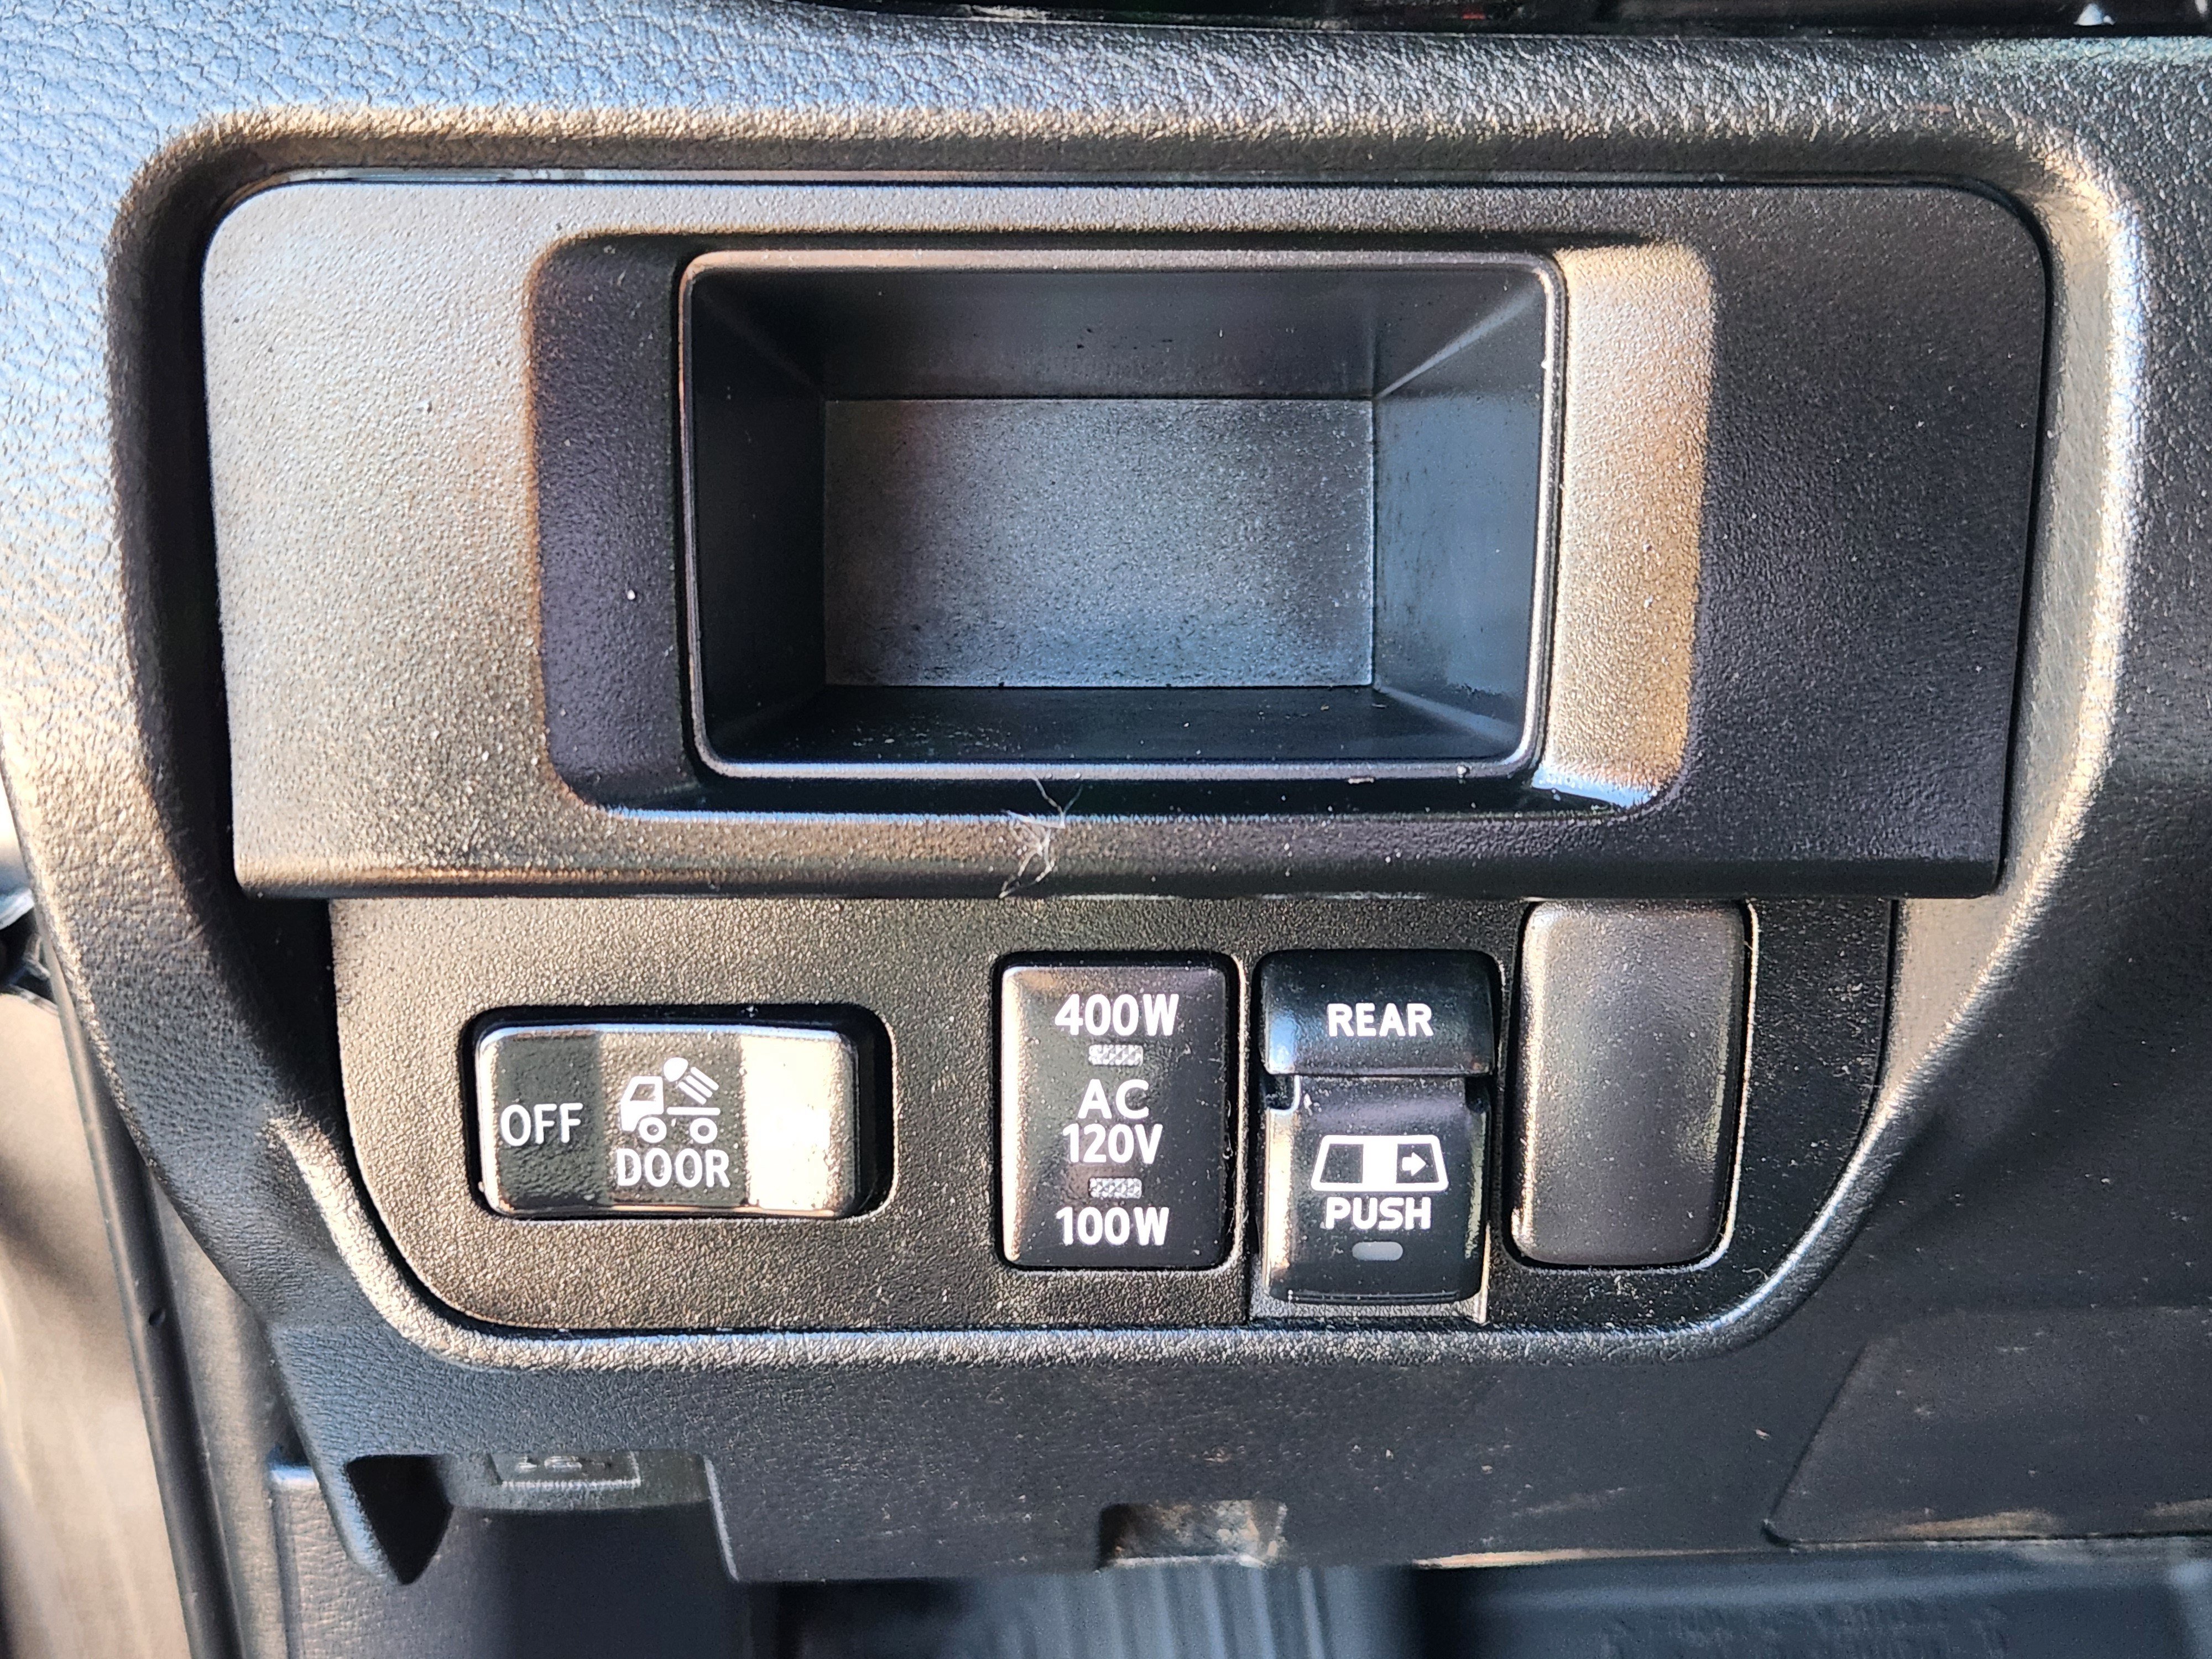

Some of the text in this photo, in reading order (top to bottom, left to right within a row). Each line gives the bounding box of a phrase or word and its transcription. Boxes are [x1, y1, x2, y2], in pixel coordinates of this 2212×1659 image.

[1055, 994, 1178, 1036] 400W
[1327, 1003, 1433, 1037] REAR
[1078, 1078, 1149, 1119] AC
[500, 1103, 583, 1147] OFF
[1062, 1123, 1162, 1164] 120V
[616, 1149, 730, 1188] DOOR
[1056, 1206, 1169, 1245] 100W
[1326, 1197, 1431, 1230] PUSH
